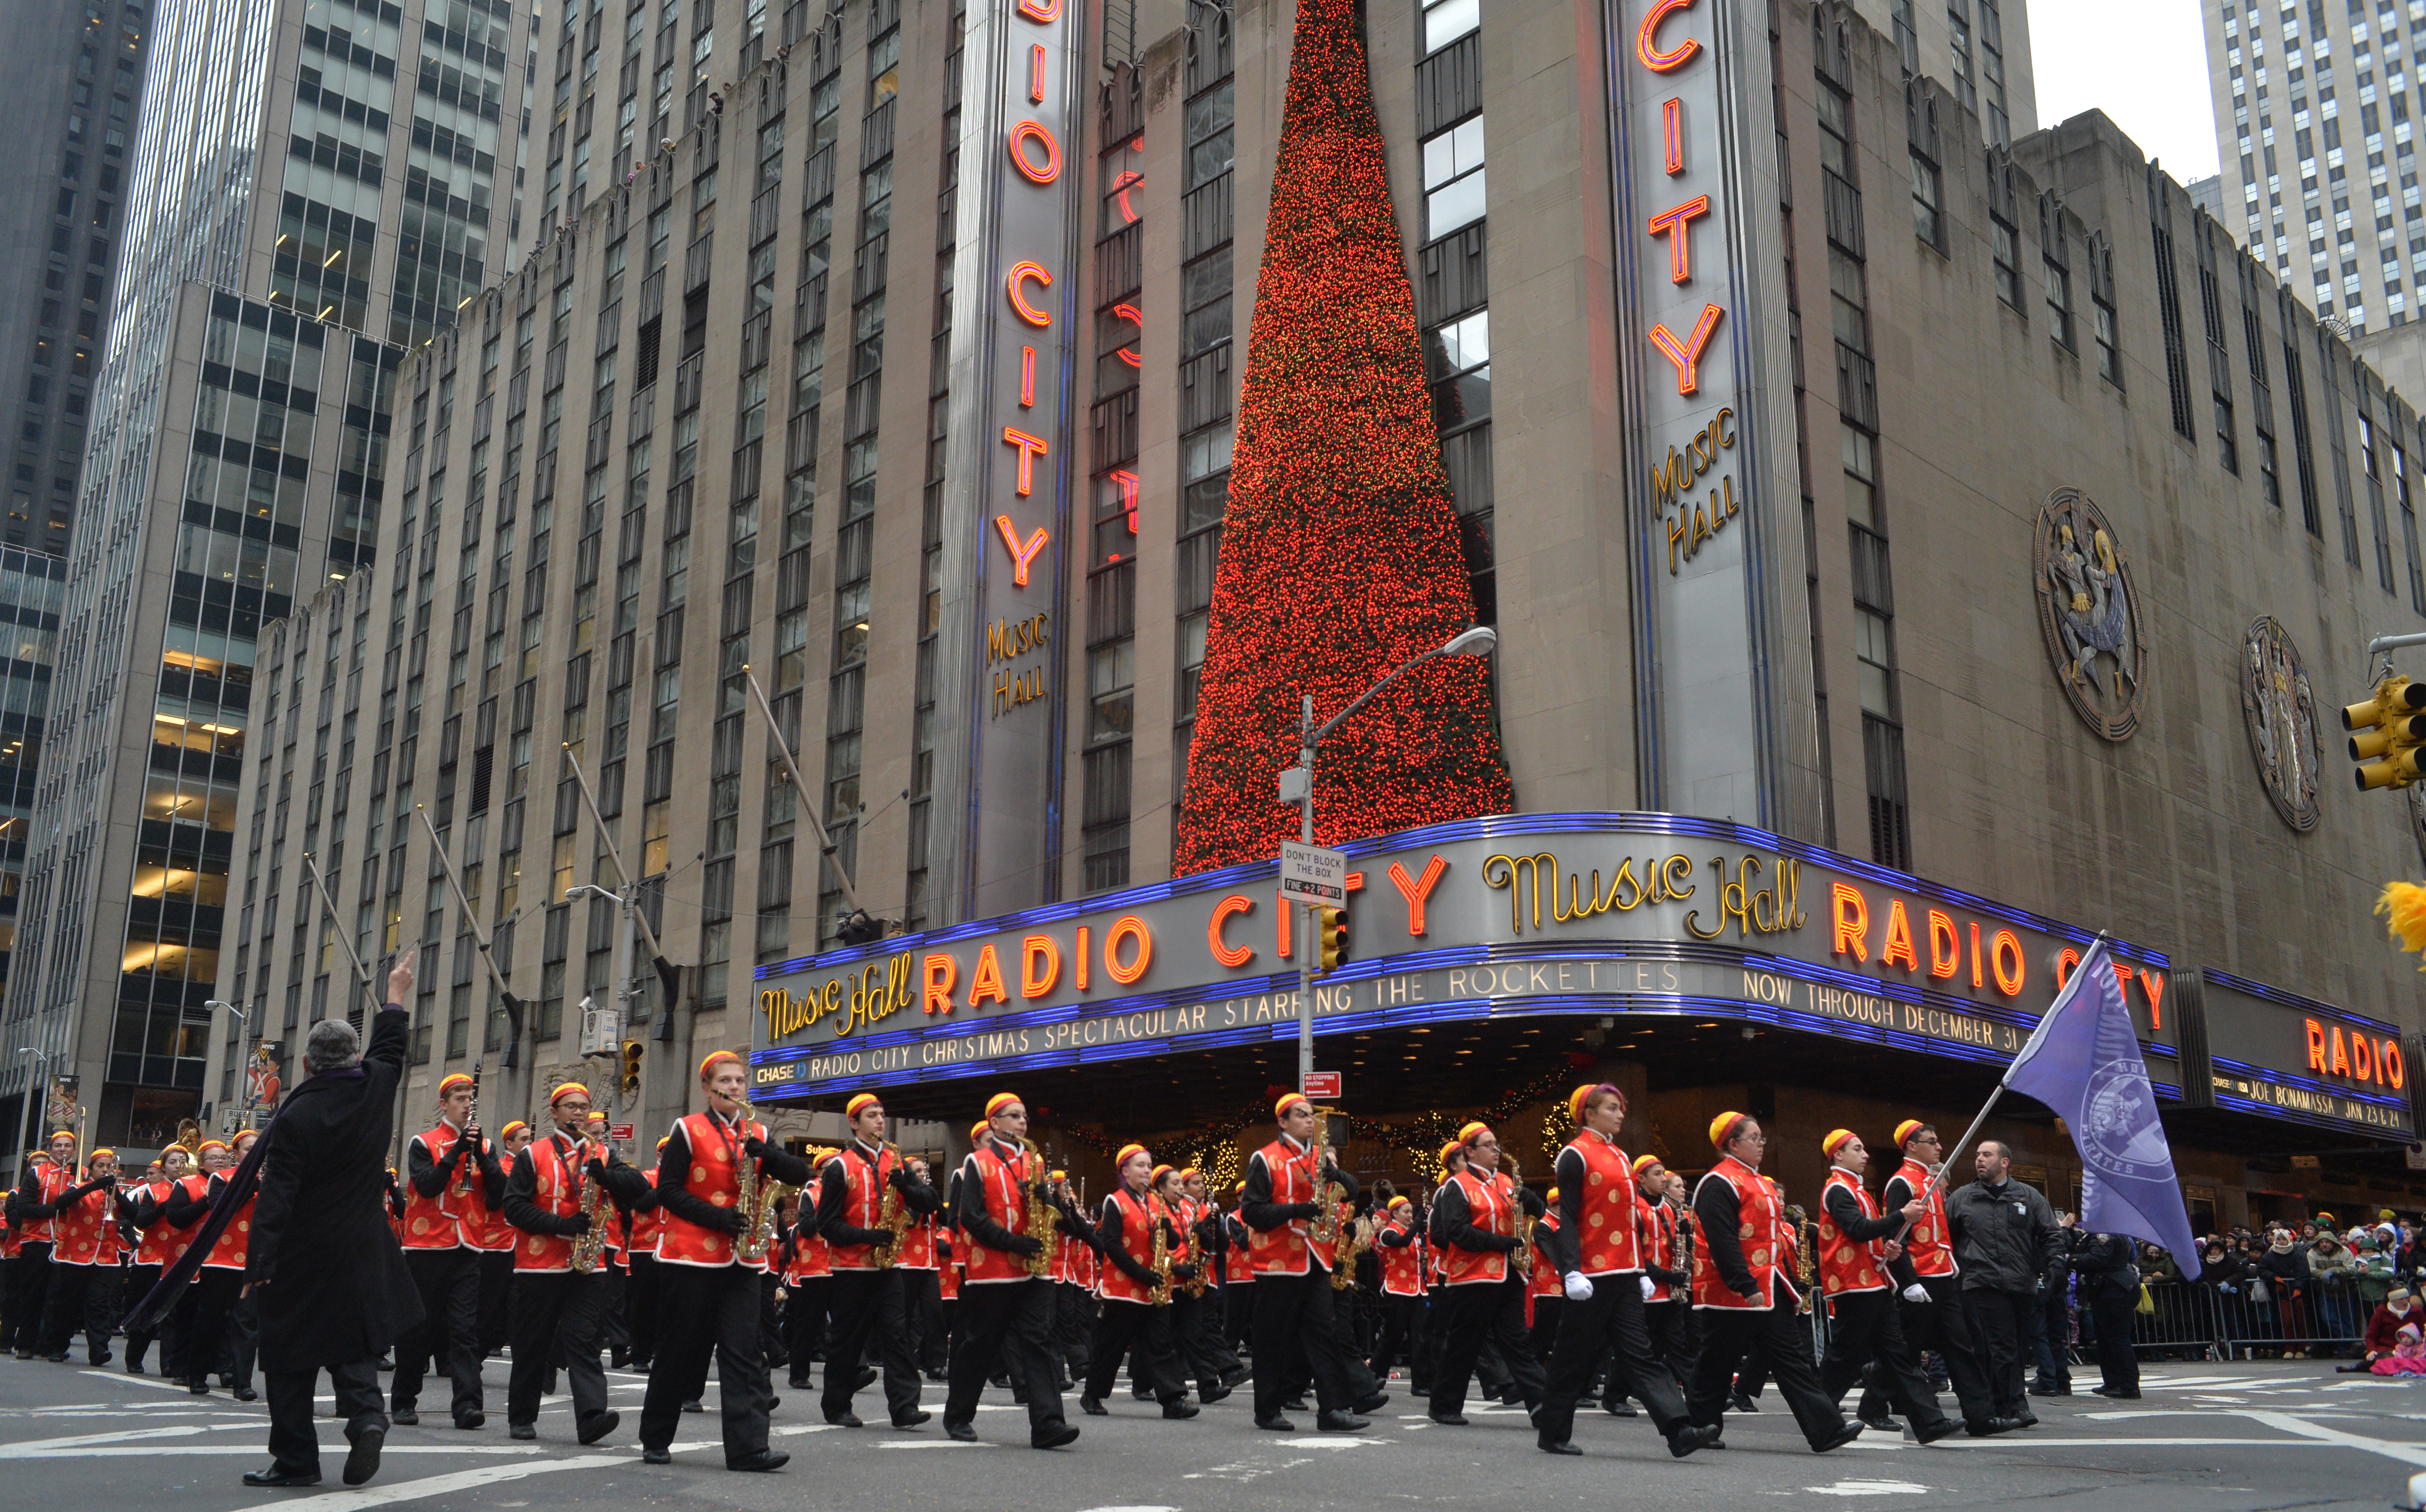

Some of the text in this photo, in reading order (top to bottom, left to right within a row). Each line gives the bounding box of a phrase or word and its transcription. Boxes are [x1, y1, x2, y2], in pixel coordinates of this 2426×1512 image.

[1637, 0, 1724, 396] CITY
[995, 260, 1054, 586] CITY
[1653, 407, 1735, 520] MUSIC
[1667, 475, 1739, 576] HALL
[987, 613, 1047, 668] MUSIC
[992, 666, 1046, 719] HALL
[1297, 863, 1331, 879] THE BOX
[1314, 855, 1341, 868] BLOCK
[1286, 880, 1340, 899] FINE +2 POINTS
[1482, 853, 1696, 934] Music
[1687, 854, 1807, 939] Hall
[1832, 881, 2025, 996] RADIO
[760, 978, 841, 1043] Music
[833, 950, 915, 1036] Hall
[923, 915, 1152, 1014] RADIO
[811, 962, 1678, 1079] RADIO CITY CHRISTMAS SPECTACULAR STARRNG THE ROCKETTES
[1744, 971, 2017, 1050] NOW THROUGH DECEMBER 31
[757, 1064, 795, 1083] CHASE
[2305, 1019, 2403, 1090] RADIO
[2212, 1076, 2230, 1089] CHASE
[2250, 1080, 2271, 1102] JOE
[2275, 1085, 2335, 1115] BONAMASSA
[2345, 1101, 2363, 1120] JAN
[2366, 1105, 2377, 1123] 23
[2389, 1110, 2400, 1128] 24
[806, 1144, 842, 1155] Suby
[2082, 1123, 2134, 1174] PIRATES
